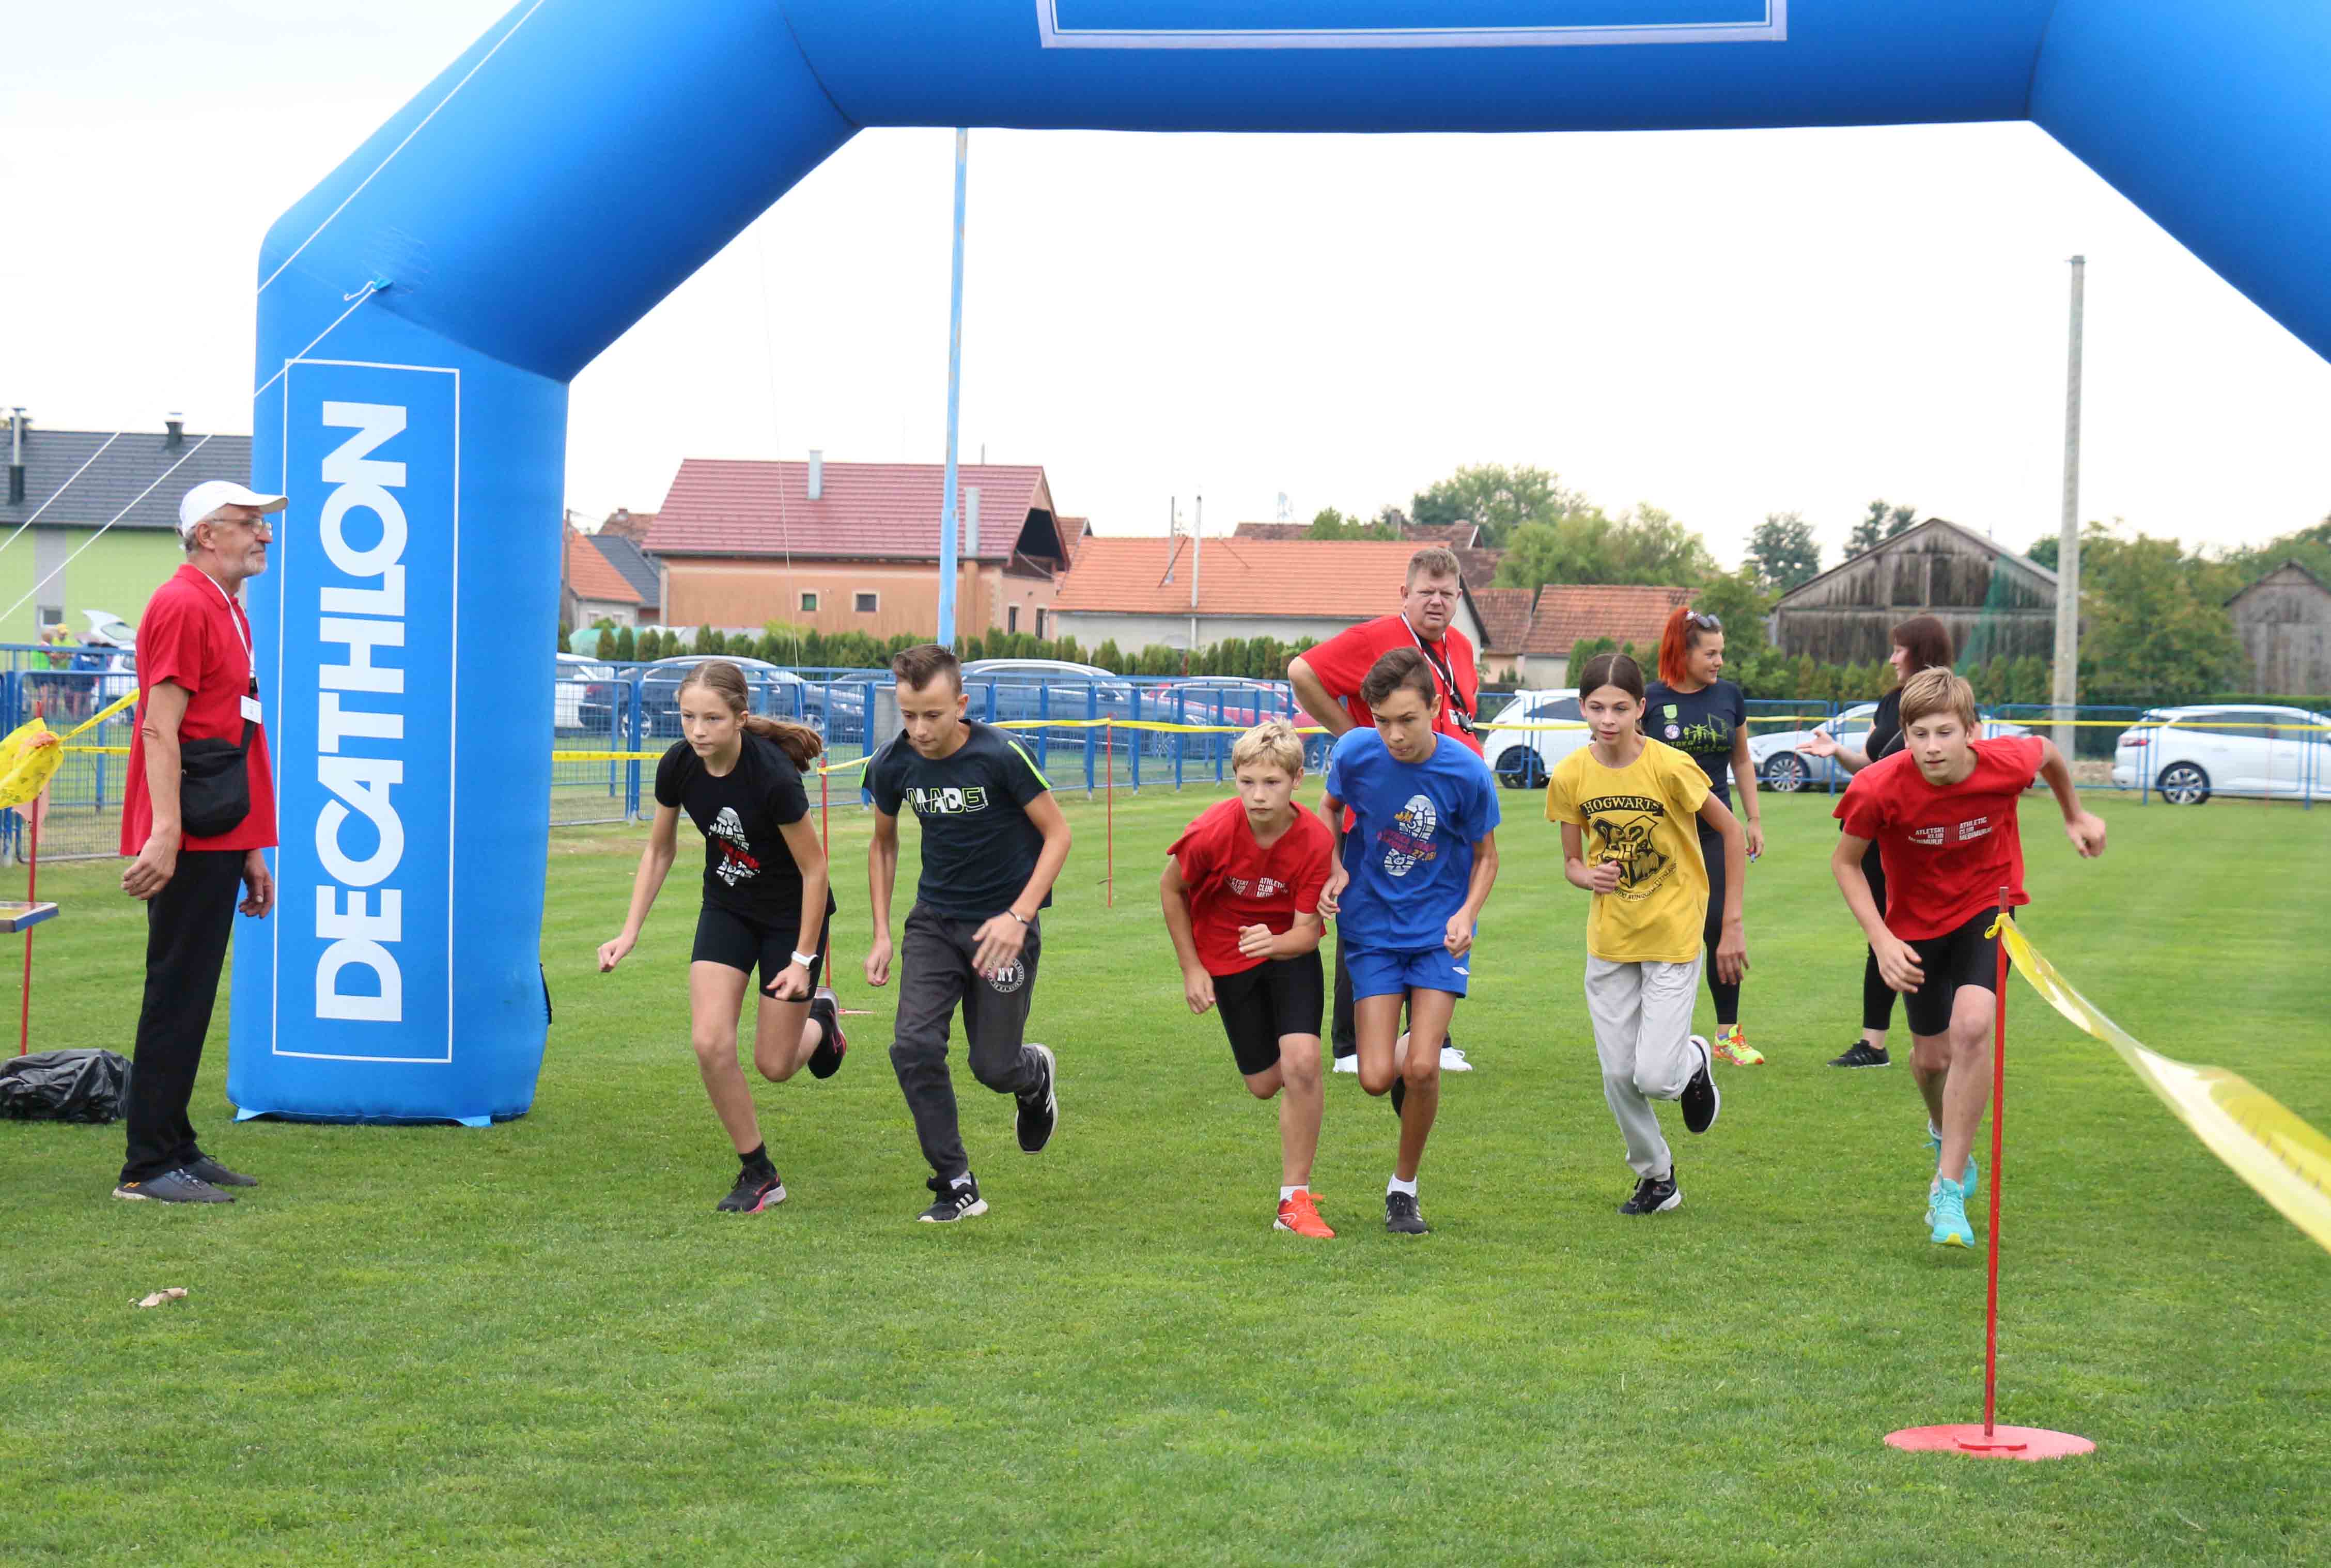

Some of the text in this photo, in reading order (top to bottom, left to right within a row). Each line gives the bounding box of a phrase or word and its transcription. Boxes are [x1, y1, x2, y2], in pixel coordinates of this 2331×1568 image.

[316, 401, 408, 1022] DECATHLON
[1582, 797, 1660, 813] HOGWARTS
[1959, 817, 1987, 829] ATHLETIC
[1915, 827, 1945, 835] ATLETSKI
[1258, 884, 1273, 892] CLUB
[1260, 877, 1286, 888] ATHLETIC
[997, 967, 1014, 982] NY
